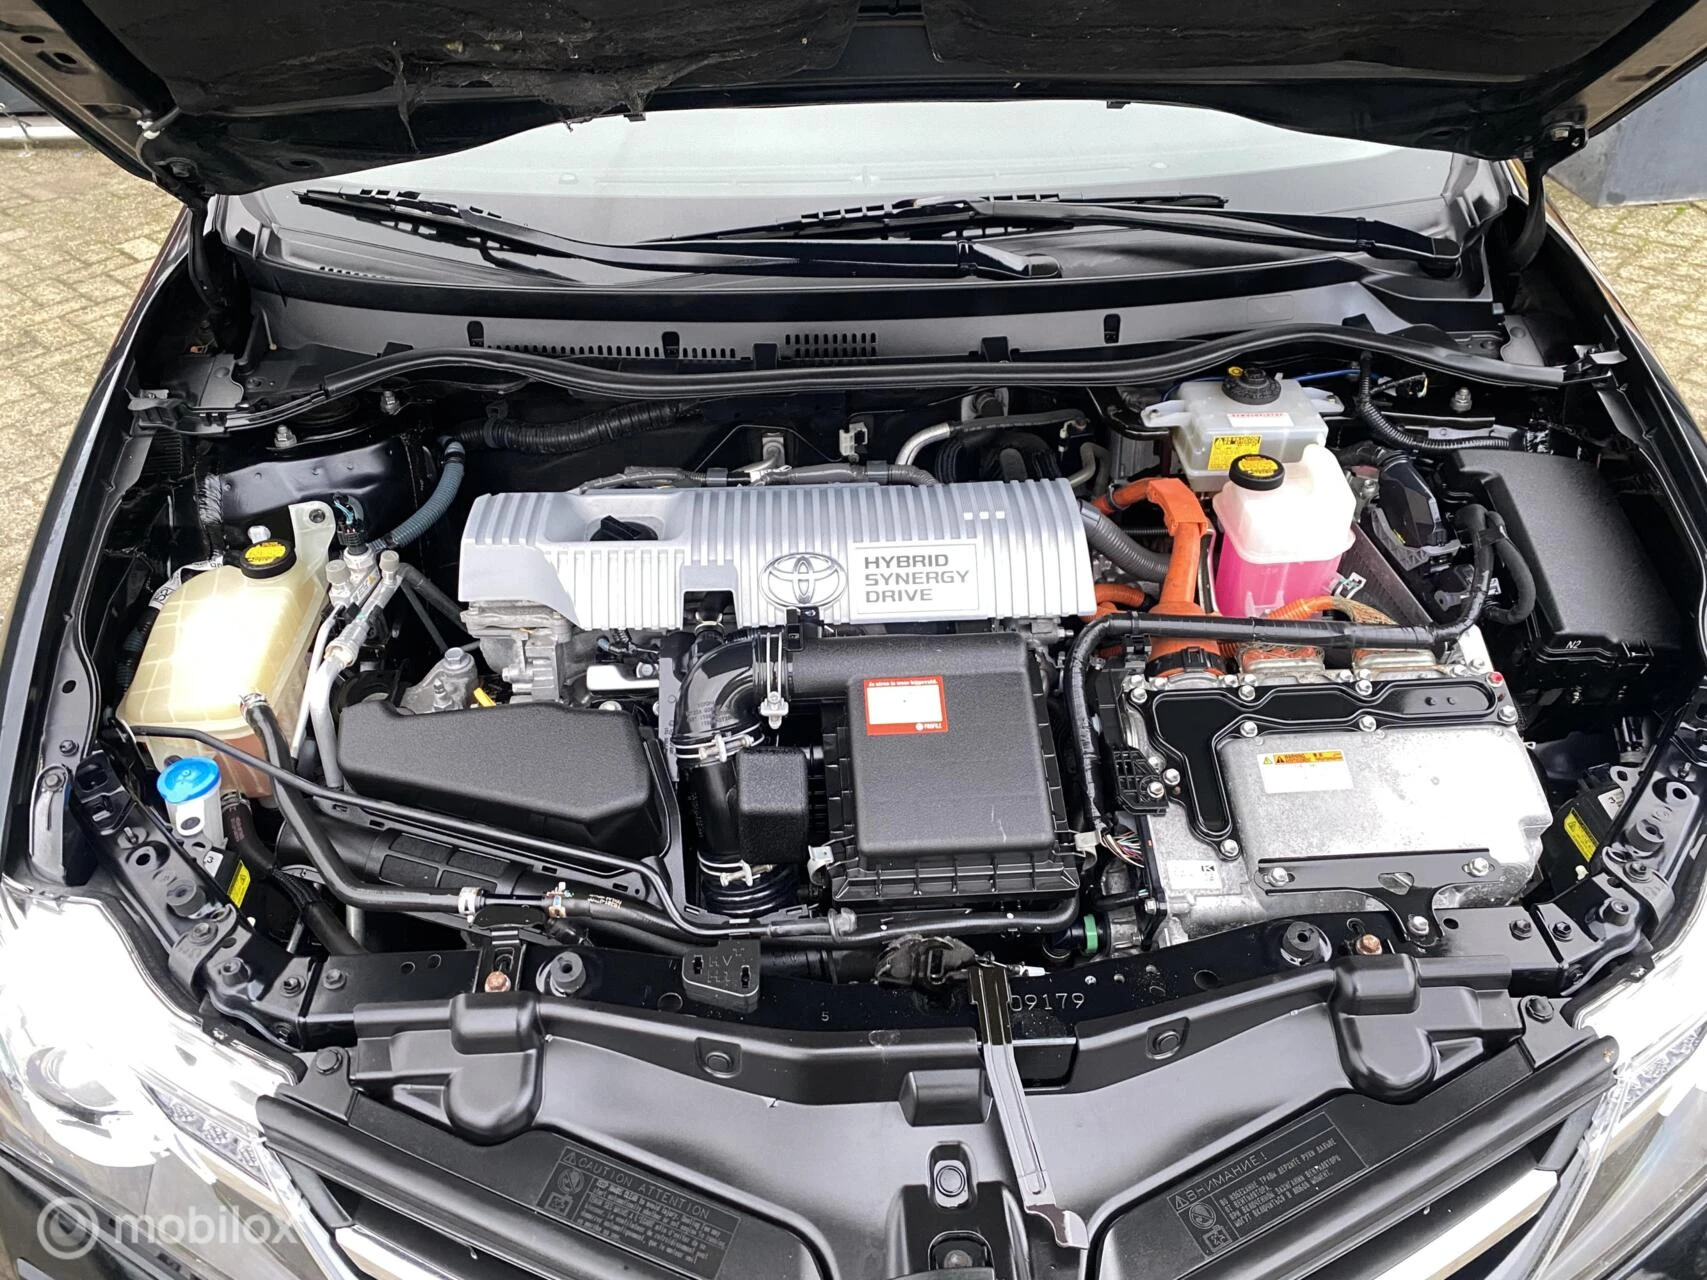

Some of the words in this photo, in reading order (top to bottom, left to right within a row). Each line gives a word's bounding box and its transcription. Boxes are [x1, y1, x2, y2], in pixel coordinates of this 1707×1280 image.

[864, 554, 949, 569] HYBRID
[865, 570, 970, 586] SYNERGY
[865, 588, 934, 603] DRIVE
[1185, 1155, 1260, 1201] ВНИМАНИЕ
[578, 1157, 633, 1187] CAUTION
[638, 1182, 710, 1220] ATTENTION
